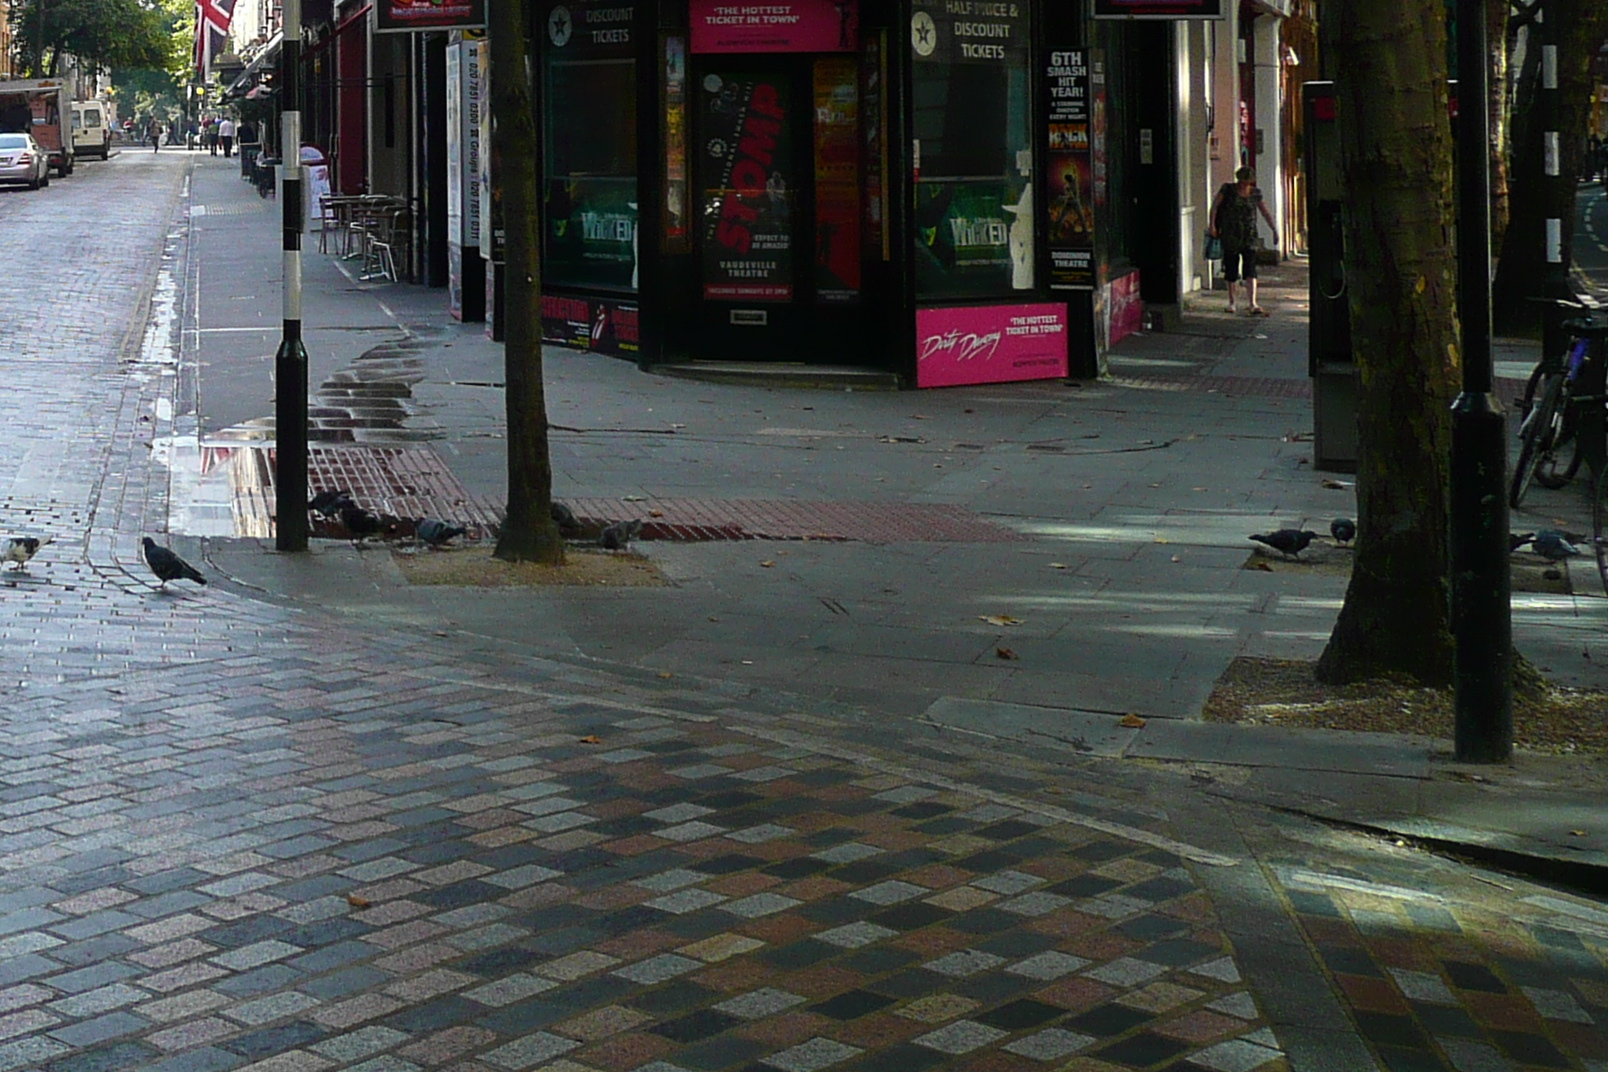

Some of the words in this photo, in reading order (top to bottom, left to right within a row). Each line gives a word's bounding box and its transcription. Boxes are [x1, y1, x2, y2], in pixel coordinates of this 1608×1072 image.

[586, 7, 634, 23] DISCOUNT
[741, 5, 792, 15] HOTTEST
[945, 0, 973, 15] HALF
[1009, 3, 1019, 18] &
[705, 15, 745, 25] TICKET
[747, 16, 760, 24] IN
[592, 28, 630, 43] TICKETS
[954, 21, 1011, 38] DISCOUNT
[960, 43, 1005, 59] TICKETS
[1051, 51, 1082, 66] 6TH
[1047, 66, 1087, 77] SMASH
[1058, 76, 1077, 86] HIT
[1050, 87, 1084, 97] YEAR!
[716, 82, 786, 256] STOMP
[471, 180, 480, 198] 020
[950, 217, 1008, 246] WICKED
[718, 260, 777, 269] VAUDEVILLE
[1054, 260, 1089, 268] THEATRE
[727, 269, 769, 278] THEATRE
[1027, 314, 1059, 324] HOTTEST
[1005, 326, 1030, 335] TICKET
[1030, 325, 1039, 334] IN
[920, 329, 962, 361] Dirty
